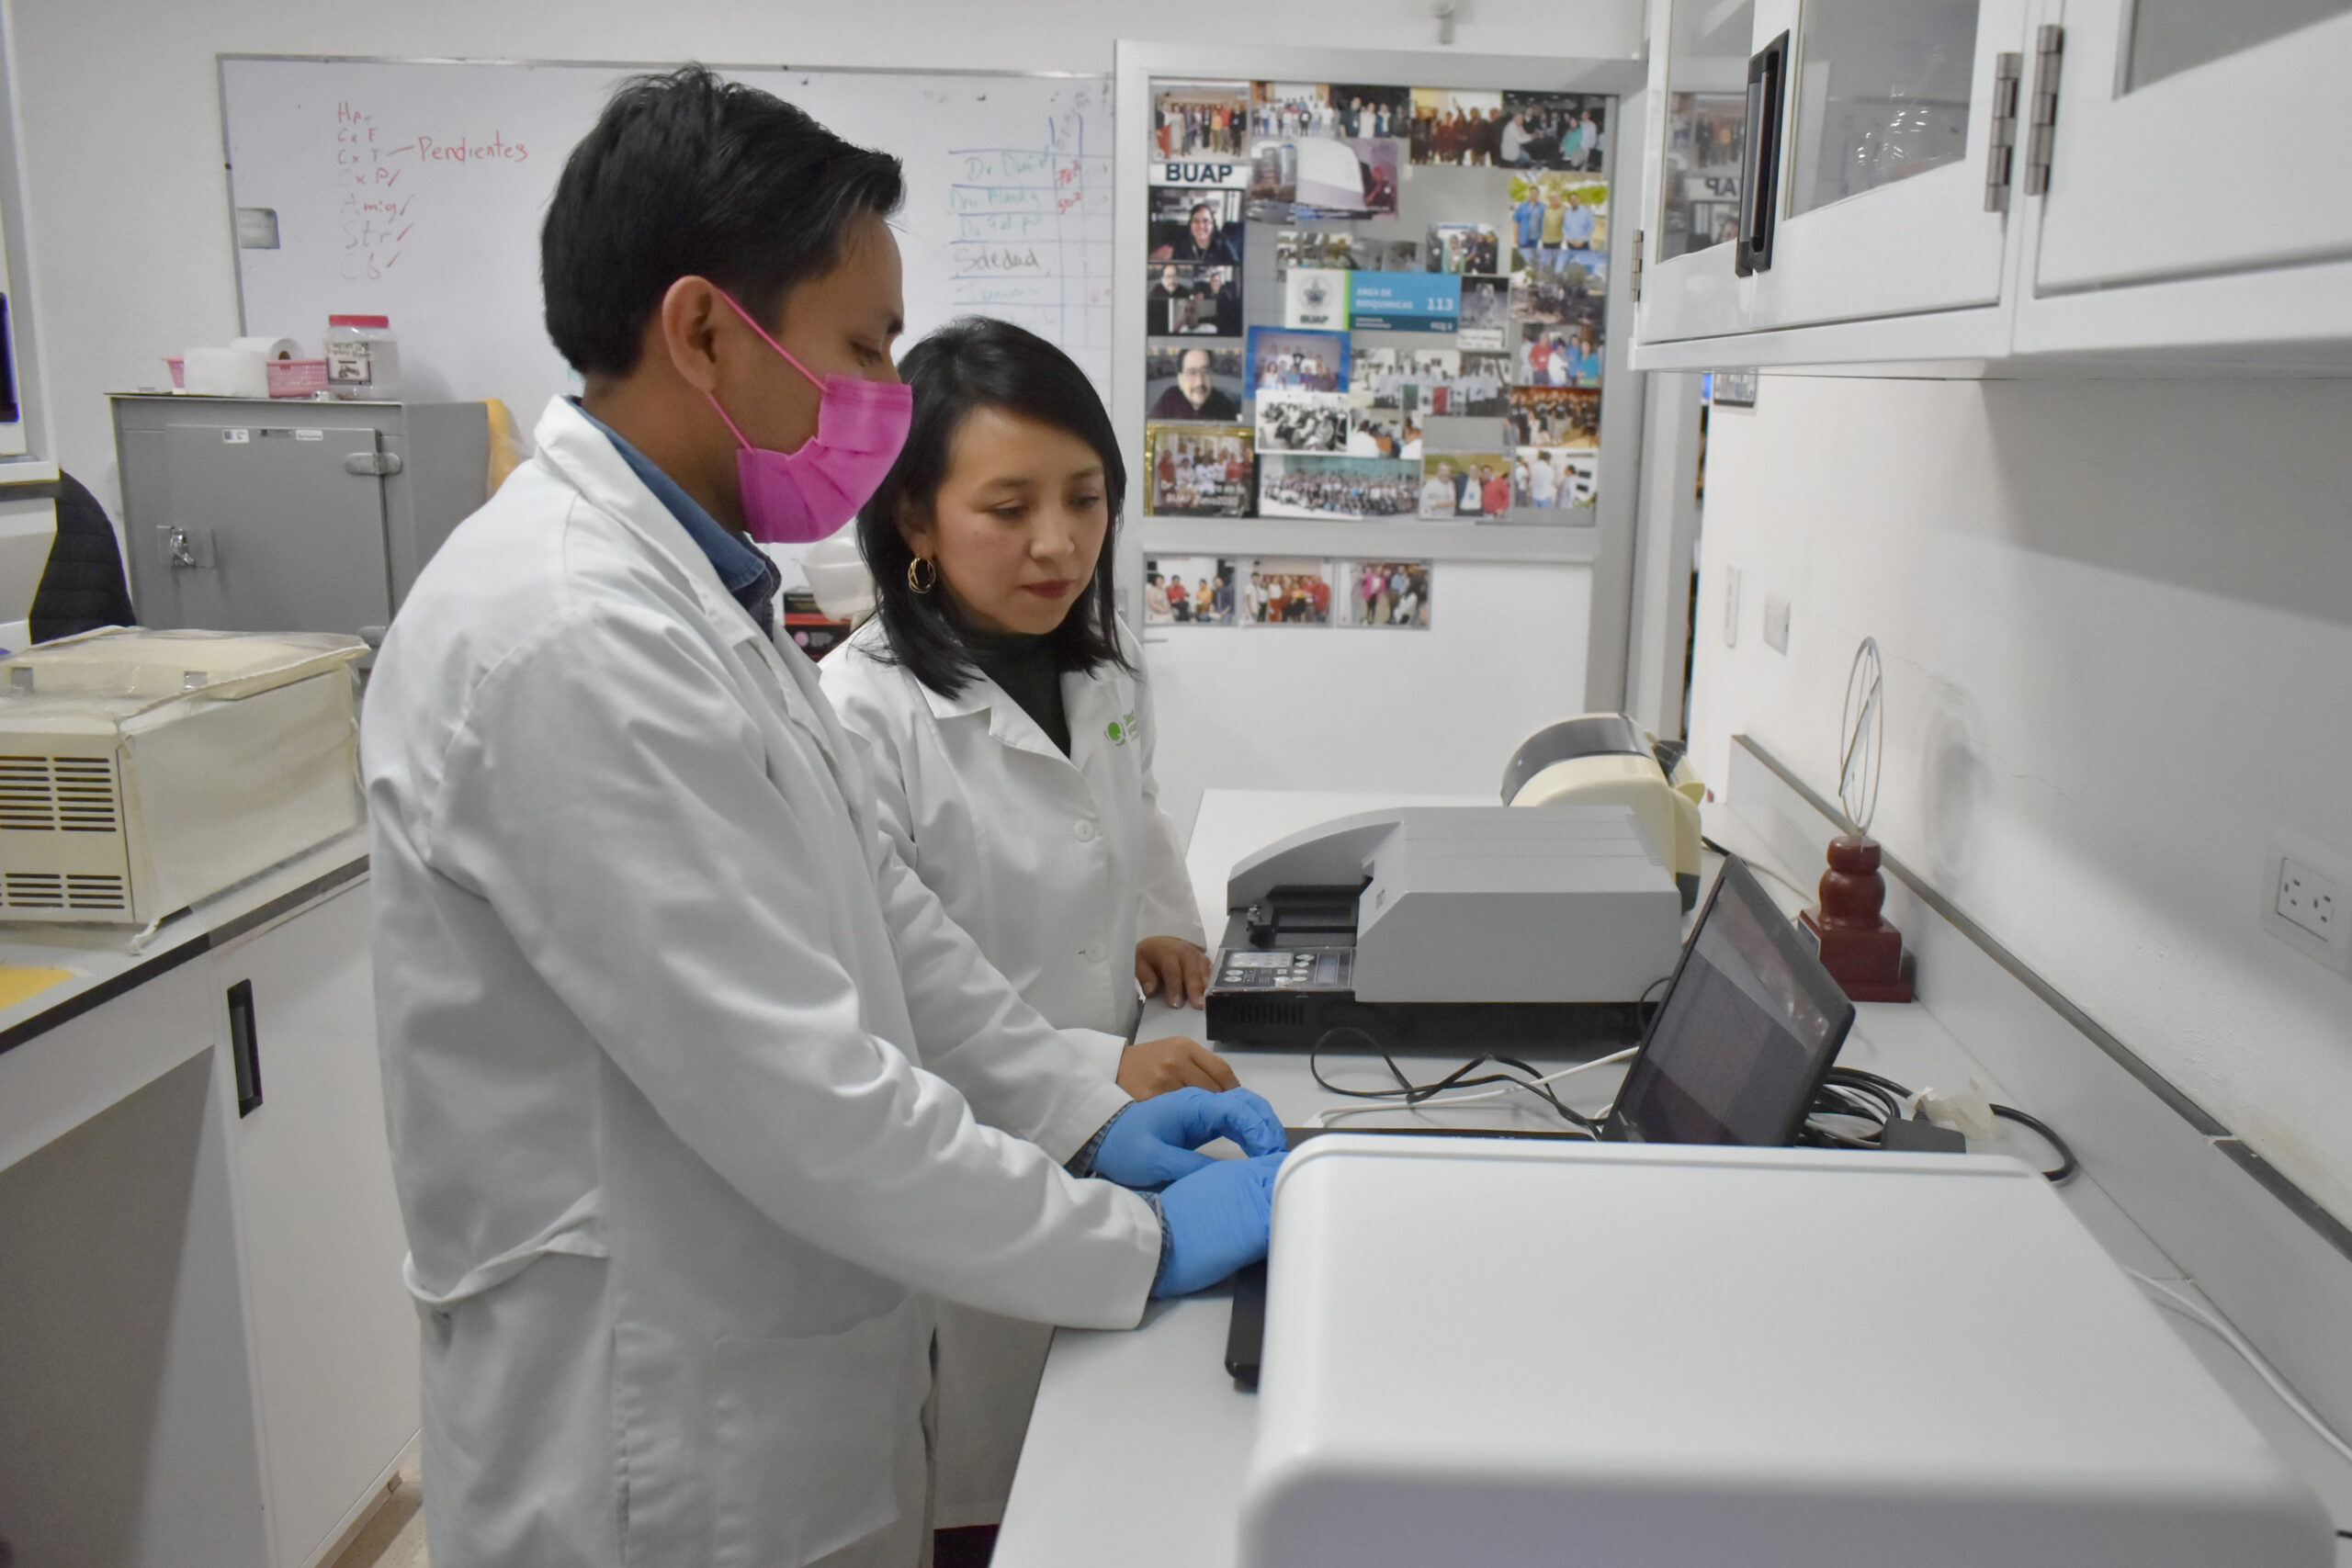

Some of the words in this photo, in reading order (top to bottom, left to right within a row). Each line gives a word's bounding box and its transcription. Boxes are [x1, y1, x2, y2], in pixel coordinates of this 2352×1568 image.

[419, 130, 529, 164] Pendientes
[1166, 163, 1233, 182] BUAP
[1428, 298, 1453, 310] 113
